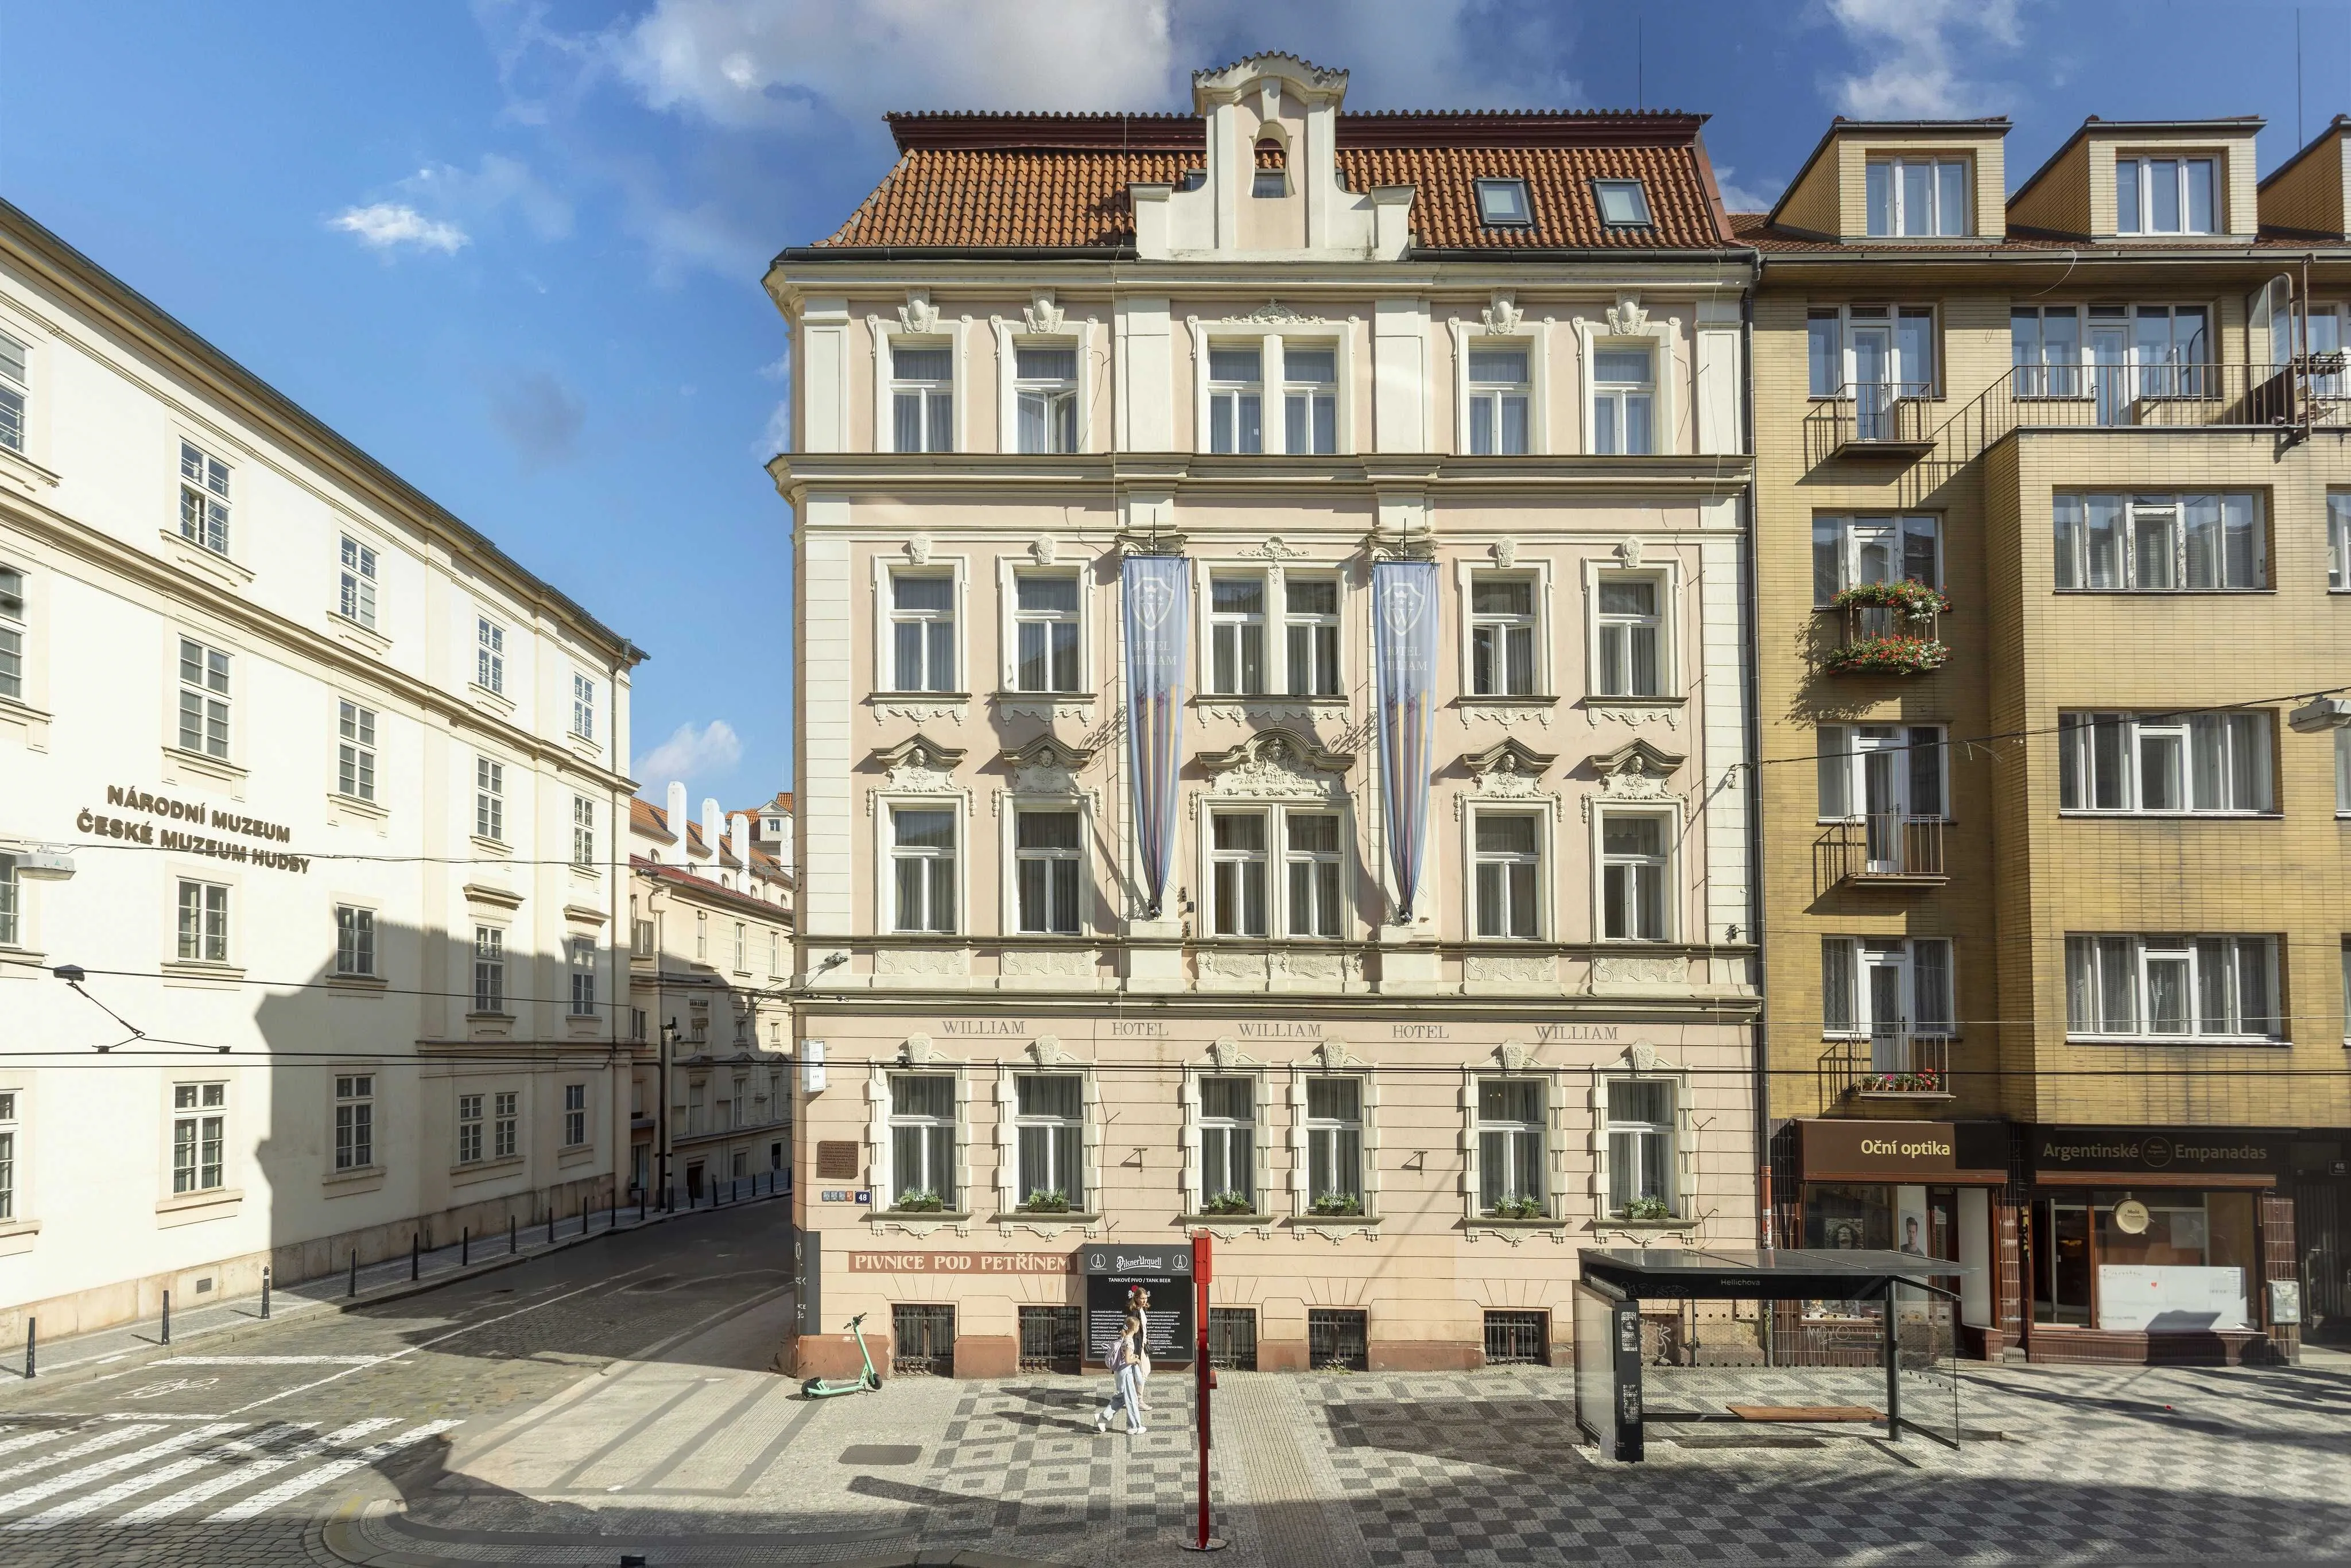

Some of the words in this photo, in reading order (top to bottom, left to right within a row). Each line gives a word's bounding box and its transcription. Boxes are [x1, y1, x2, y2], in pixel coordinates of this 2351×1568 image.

[1134, 641, 1170, 651] HOTEL
[1384, 646, 1421, 656] HOTEL
[107, 785, 205, 824] NÁRODNÍ
[212, 810, 290, 843] MUZEUM
[77, 807, 153, 844] ČESKÉ
[161, 829, 247, 863] MUZEUM
[252, 848, 311, 874] HUDBY
[942, 1021, 1025, 1034] WILLIAM
[1111, 1022, 1169, 1036] HOTEL
[1237, 1023, 1322, 1037] WILLIAM
[1392, 1025, 1449, 1038] HOTEL
[1534, 1026, 1619, 1040] WILLIAM
[1861, 1139, 1897, 1155] Oční
[1901, 1140, 1950, 1158] optika
[2043, 1143, 2138, 1161] Argentinské
[2175, 1144, 2267, 1162] Empanadas
[855, 1255, 925, 1270] PIVNICE
[934, 1256, 971, 1270] POD
[981, 1253, 1070, 1270] PETŘÍNEM
[1116, 1256, 1139, 1272] Pilsner
[1139, 1255, 1162, 1269] Urquell
